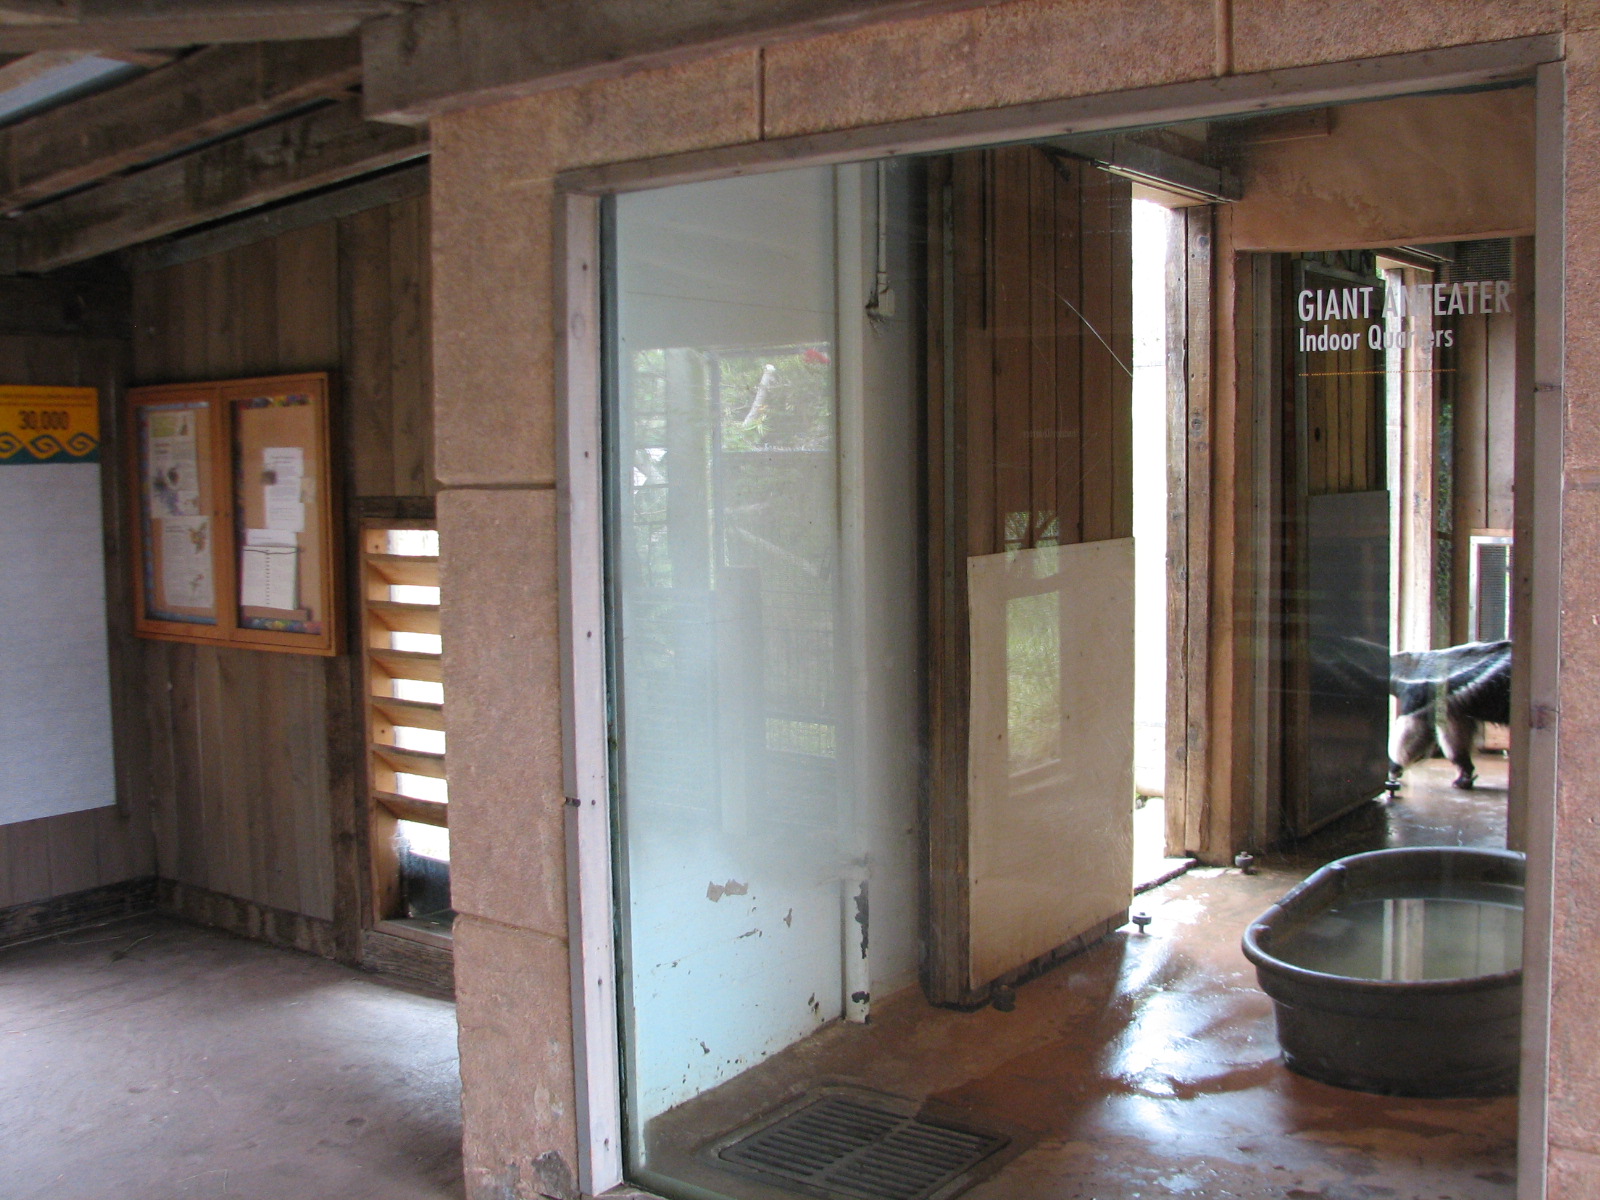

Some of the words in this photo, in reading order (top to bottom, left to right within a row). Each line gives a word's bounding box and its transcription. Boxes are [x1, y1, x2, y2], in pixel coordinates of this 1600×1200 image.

[1298, 286, 1373, 322] GIANT
[1382, 280, 1511, 318] ANTEATER
[1300, 325, 1360, 352] Indoor
[1368, 324, 1454, 350] Quarers
